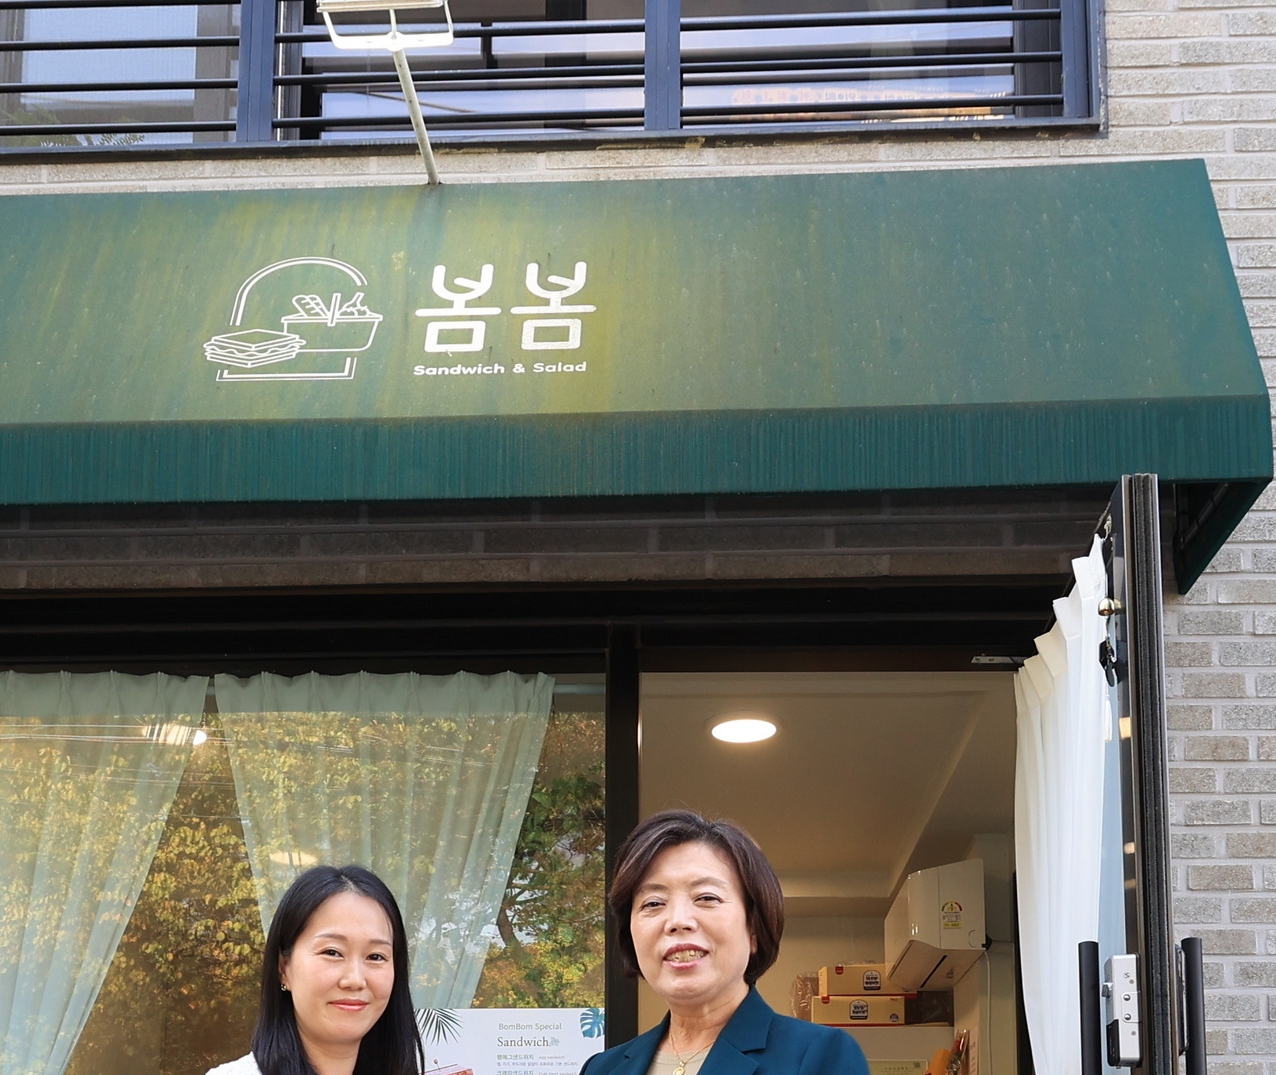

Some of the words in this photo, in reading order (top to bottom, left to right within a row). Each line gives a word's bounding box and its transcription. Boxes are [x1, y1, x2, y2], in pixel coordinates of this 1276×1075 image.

[414, 261, 597, 354] 봄봄
[413, 362, 505, 376] Sandwich
[512, 363, 526, 374] &
[532, 361, 587, 373] Salad
[498, 1023, 533, 1031] BomBom
[534, 1023, 562, 1032] Special
[497, 1036, 549, 1047] Sandwich
